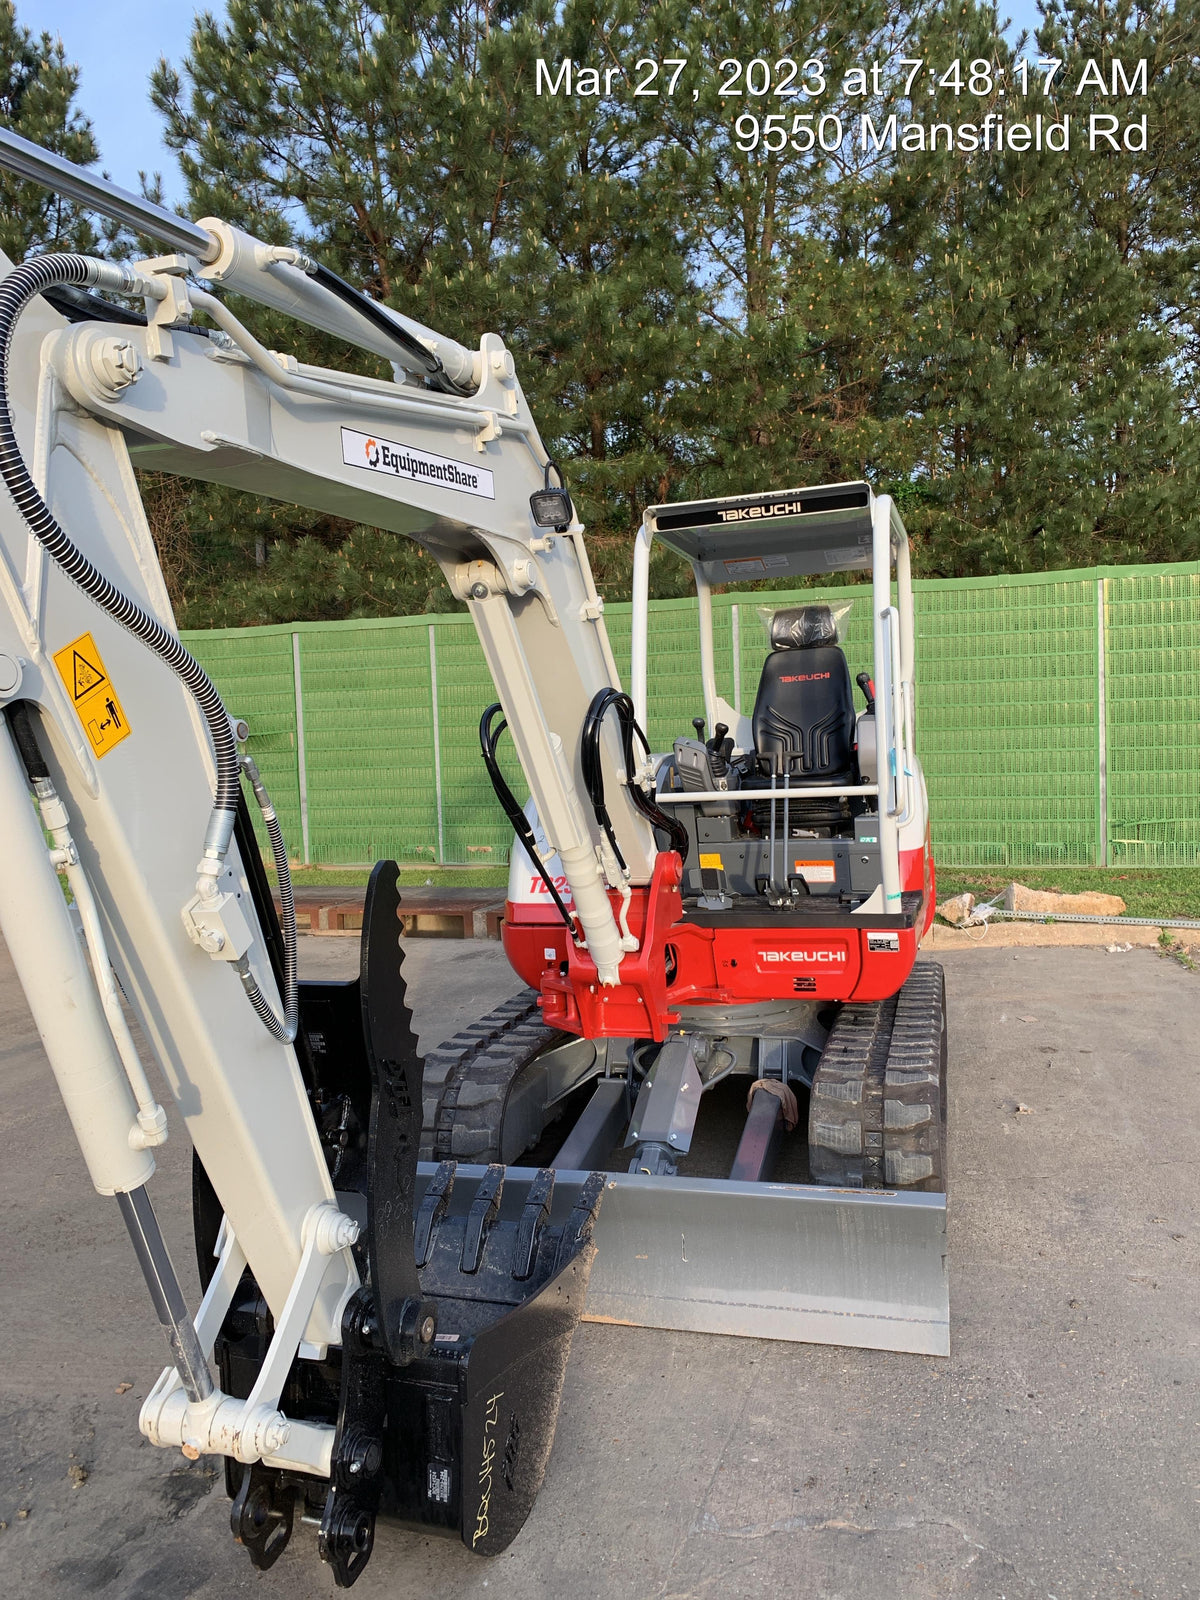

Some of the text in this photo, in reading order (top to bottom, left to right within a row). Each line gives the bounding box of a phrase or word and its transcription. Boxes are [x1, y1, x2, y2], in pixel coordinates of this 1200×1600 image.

[381, 445, 478, 489] EquipmentShare
[717, 501, 802, 522] TAKEUCHI
[779, 671, 831, 683] TAKEUCHI
[757, 951, 846, 962] TAKEUCHI
